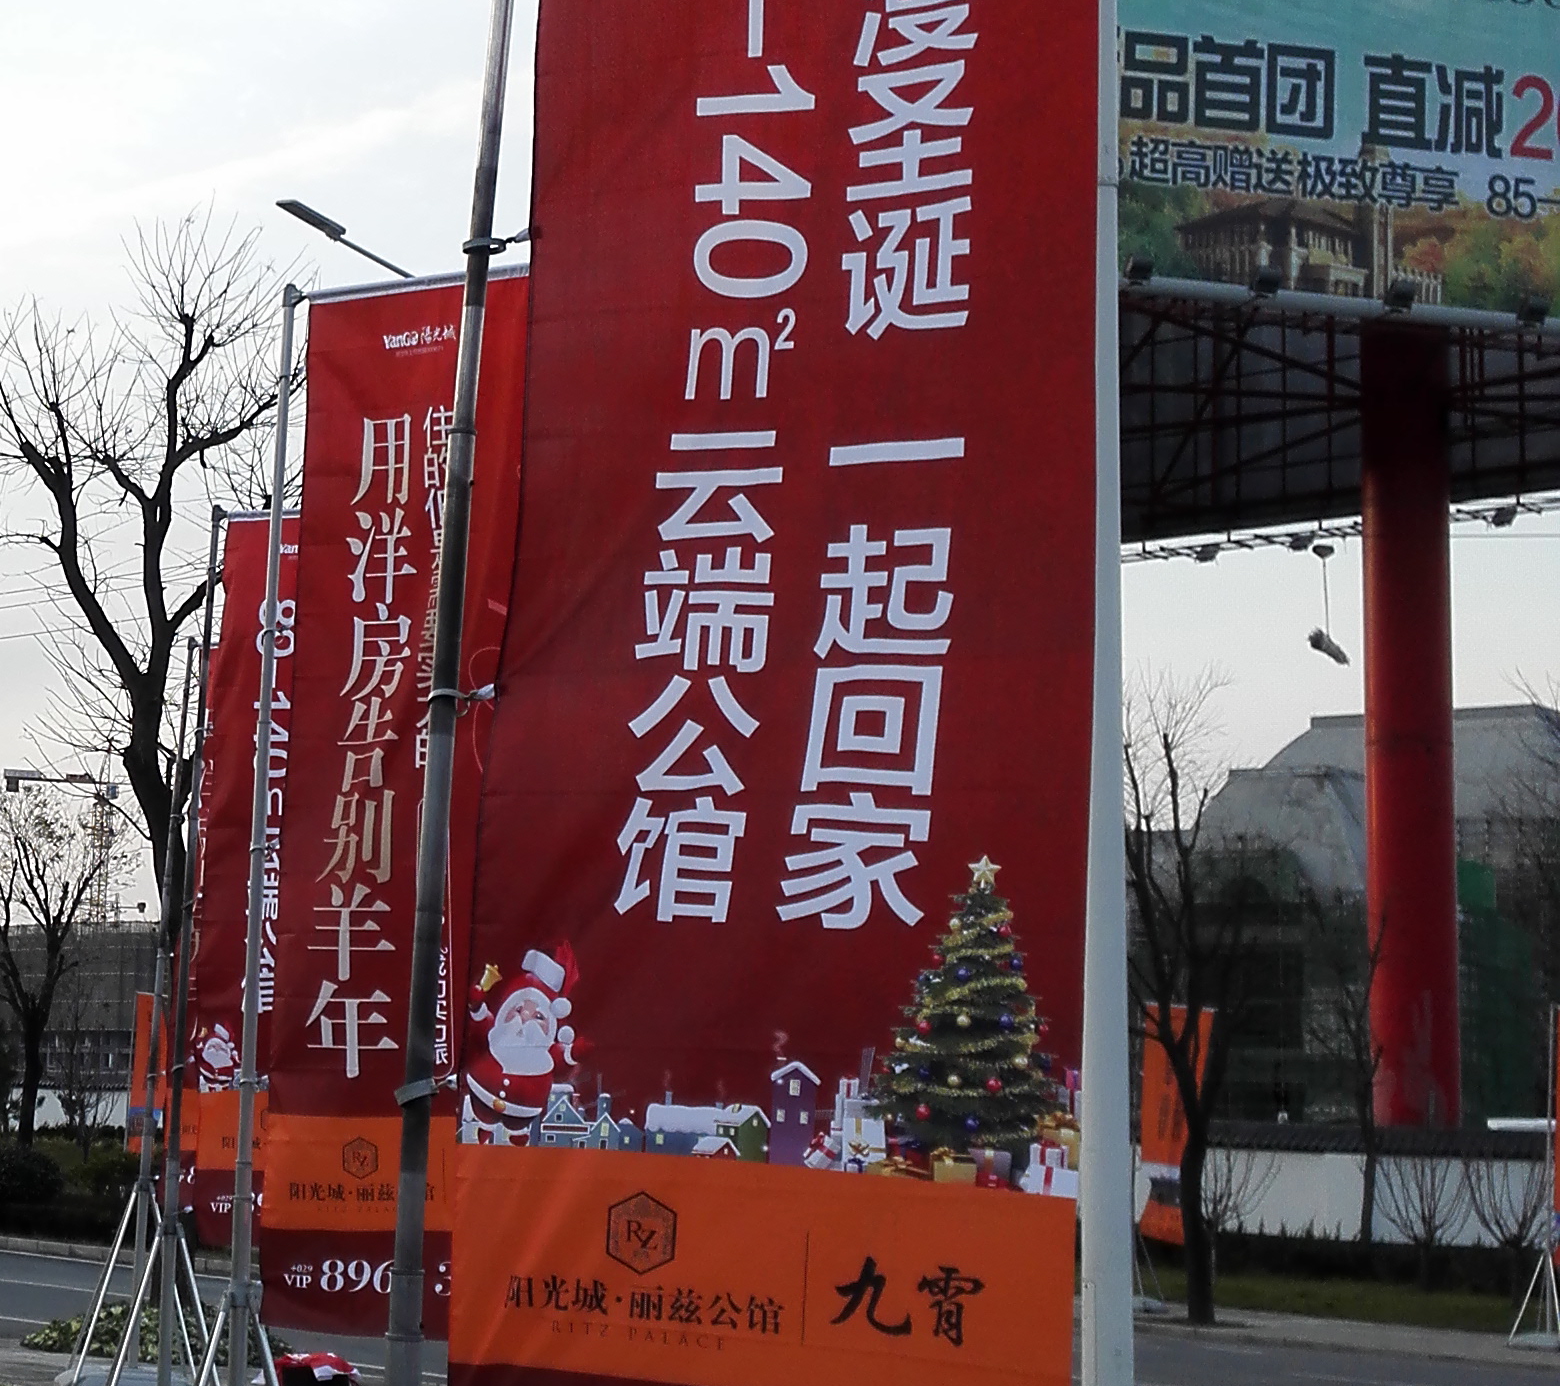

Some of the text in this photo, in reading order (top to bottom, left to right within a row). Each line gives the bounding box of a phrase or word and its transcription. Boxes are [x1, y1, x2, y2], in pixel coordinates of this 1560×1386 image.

[306, 413, 417, 1079] 用洋房告别羊年
[284, 1274, 312, 1288] VIP
[320, 1259, 395, 1294] 896
[505, 1273, 785, 1335] 阳光城·丽兹公馆
[552, 1319, 610, 1338] RITZ
